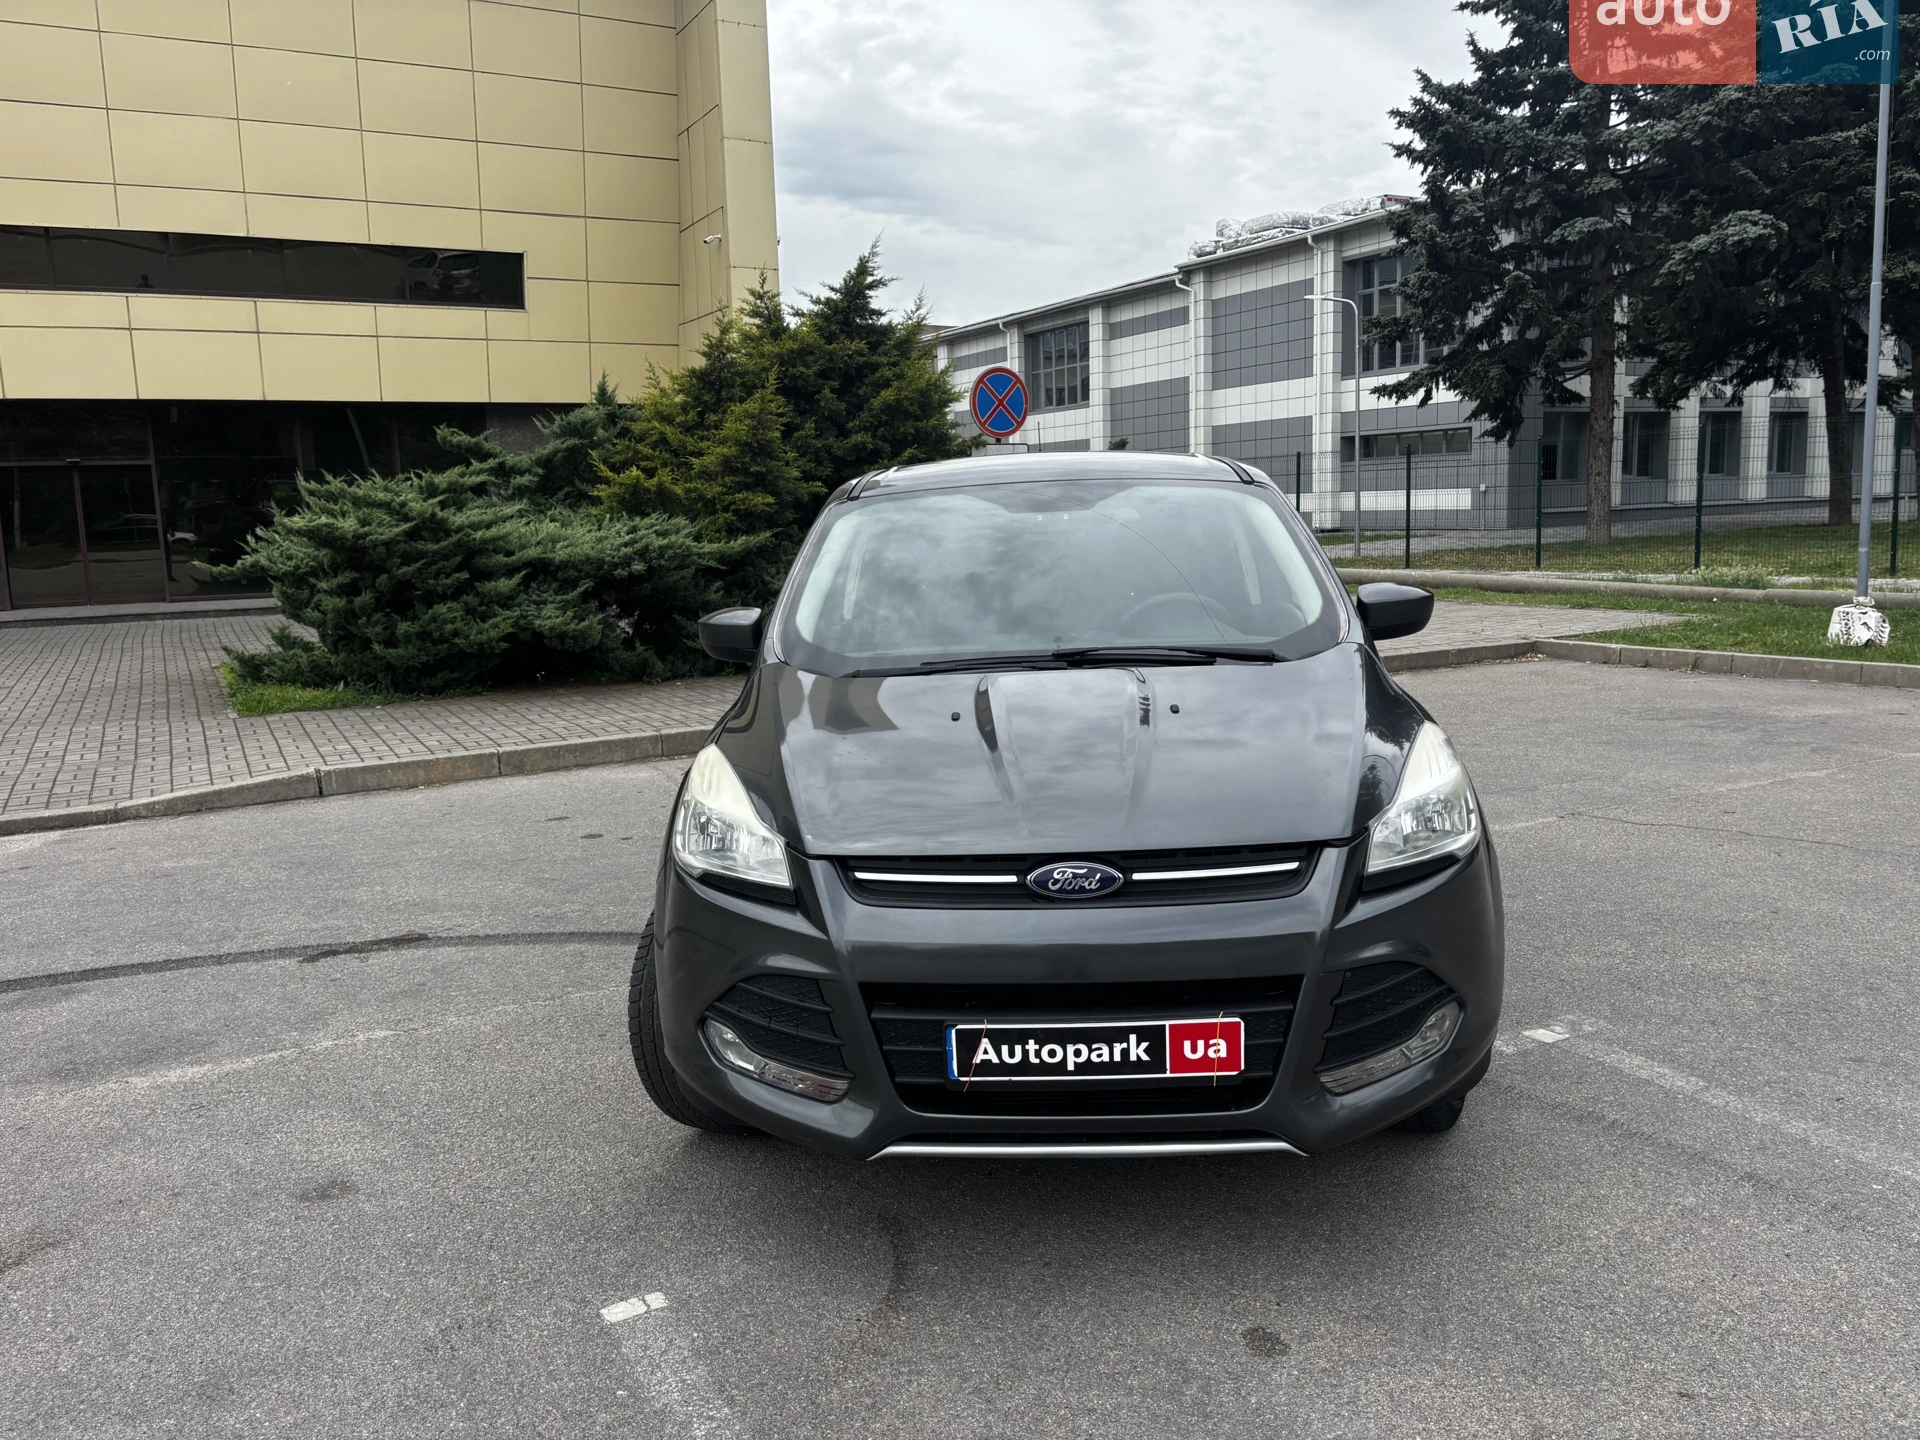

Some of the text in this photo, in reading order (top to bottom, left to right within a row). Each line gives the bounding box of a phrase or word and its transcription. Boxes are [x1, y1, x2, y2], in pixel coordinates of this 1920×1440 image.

[1048, 868, 1101, 890] Ford
[972, 1034, 1228, 1071] Autopark ua
